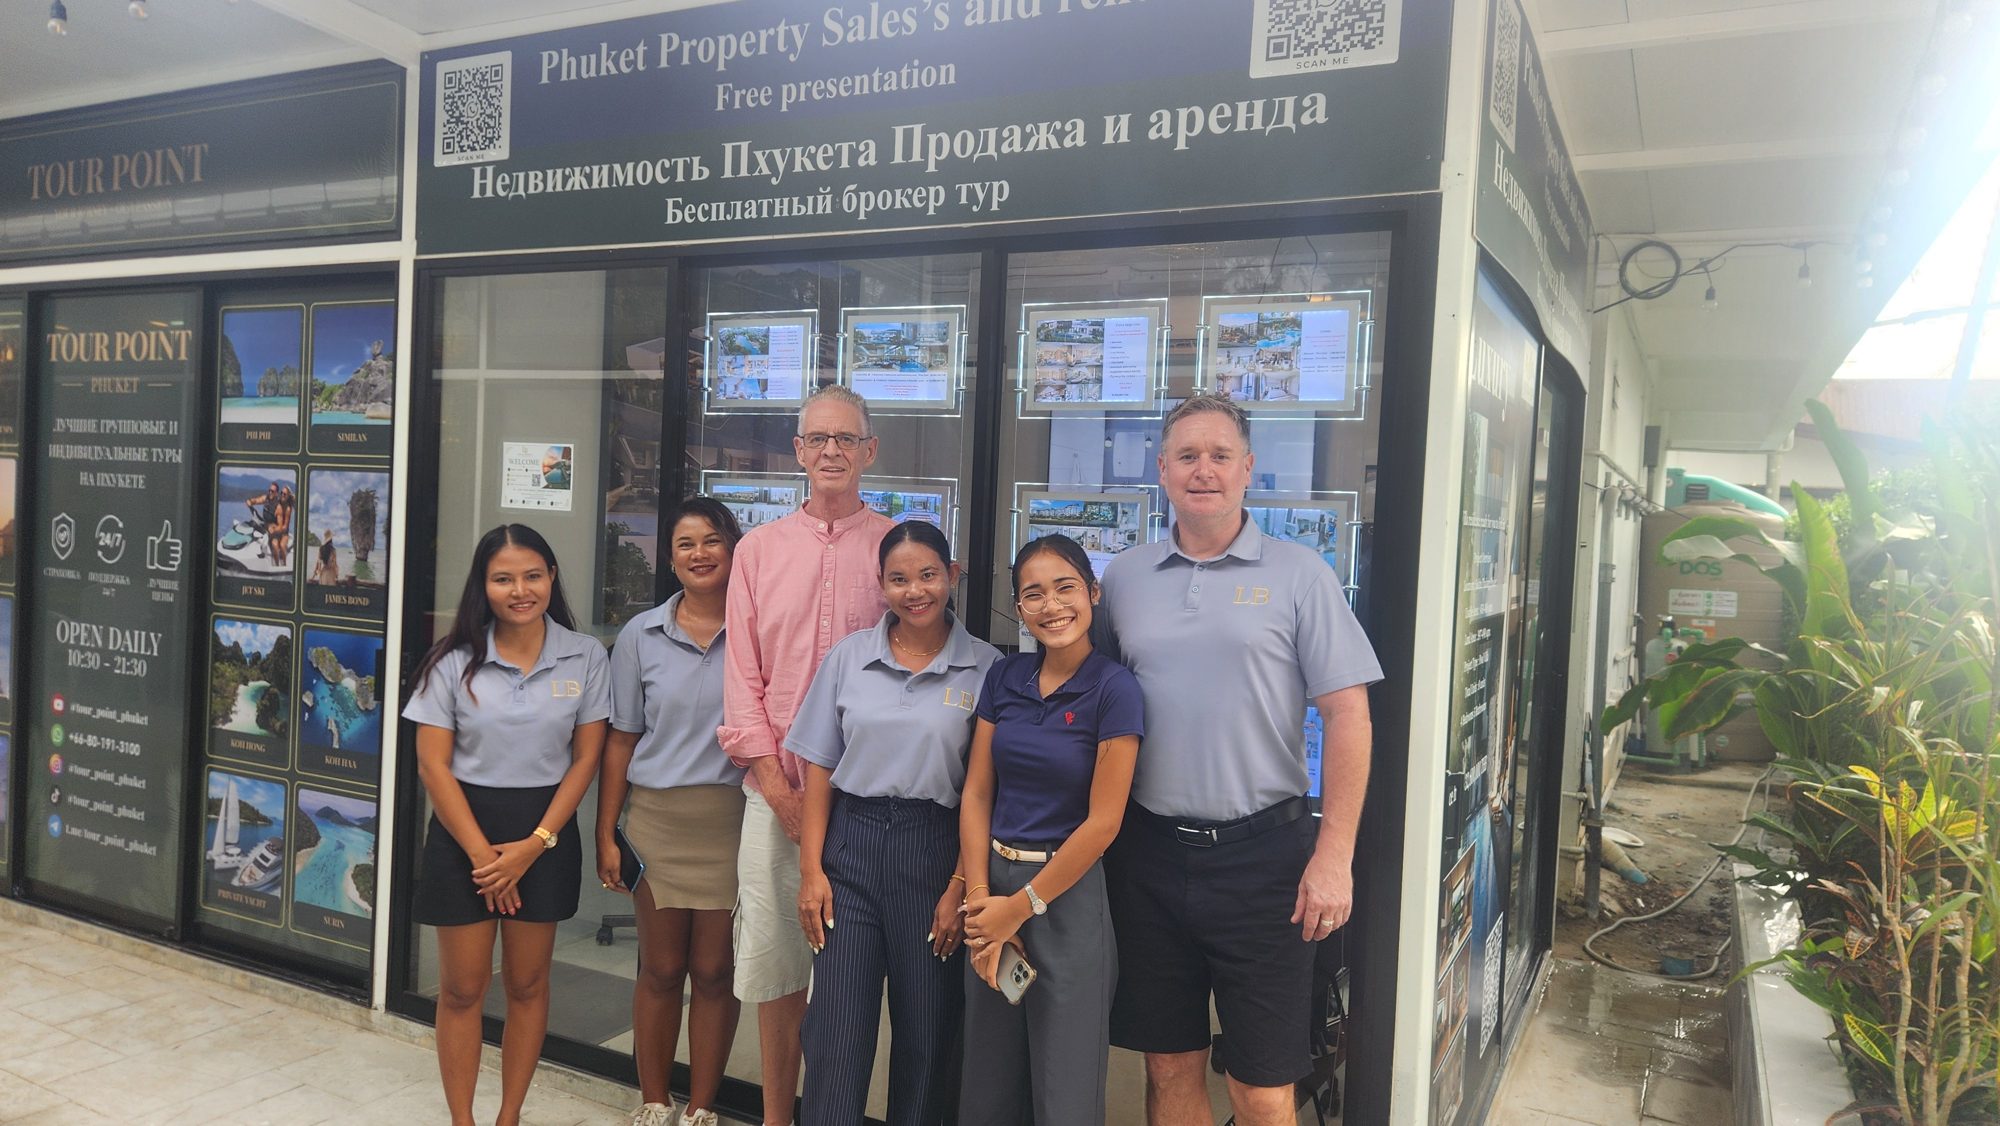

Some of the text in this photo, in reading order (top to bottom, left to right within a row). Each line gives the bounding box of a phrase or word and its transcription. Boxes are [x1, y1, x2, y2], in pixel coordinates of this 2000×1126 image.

[538, 38, 648, 85] Phuket
[657, 17, 811, 72] Property
[1296, 56, 1350, 70] SCAN ME
[715, 59, 957, 112] Free presentation
[470, 92, 1329, 200] Недвижимость Пхукета Продажа и аренда
[27, 143, 209, 201] TOUR POINT
[664, 179, 1010, 225] Бесплатный брокер тур
[46, 329, 192, 362] TOUR POINT
[91, 376, 140, 393] PHUKET
[53, 418, 99, 433] ЛУЧШИЕ
[100, 419, 166, 435] ГРУППОВЫЕ
[337, 432, 367, 442] SIMILAN
[49, 443, 182, 463] ИНДИВИДУАЛЬНЫЕ ТУРЫ
[80, 471, 146, 489] НА ПХУКЕТЕ
[99, 532, 122, 548] 24/7
[1680, 560, 1722, 576] DOS
[325, 594, 369, 606] JAMES BOND
[1233, 586, 1269, 606] LB
[56, 619, 162, 656] OPEN DAILY
[68, 649, 100, 670] 10:30
[114, 655, 147, 677] 21:30
[552, 680, 581, 697] LB
[943, 687, 975, 711] LB
[69, 732, 141, 756] +66-80-191-3100
[230, 738, 247, 750] KOH
[325, 755, 341, 767] KOH
[323, 915, 345, 929] SURIN
